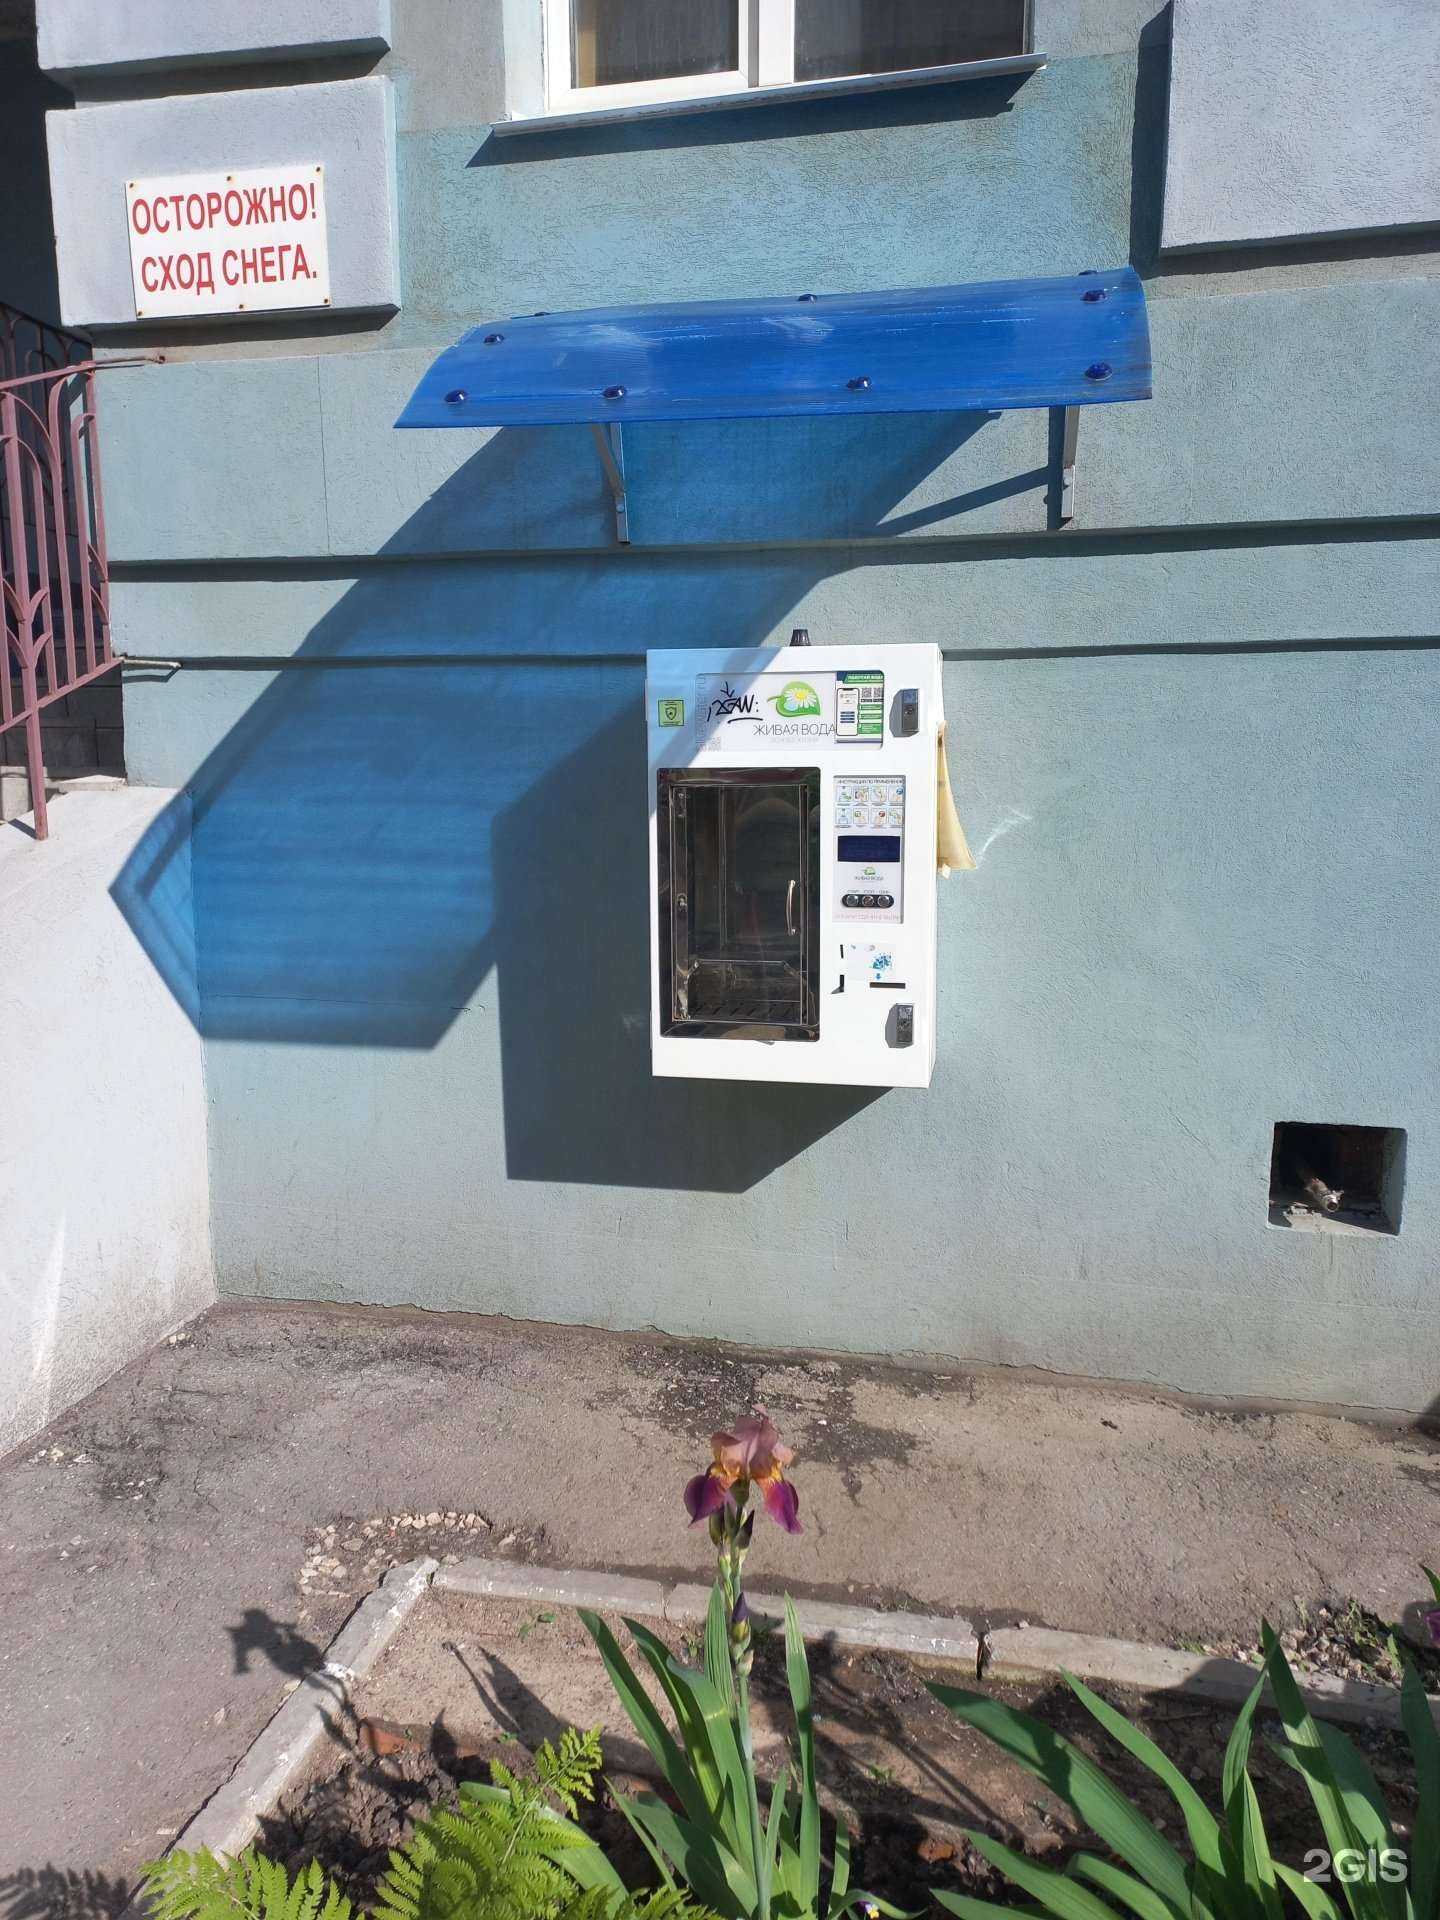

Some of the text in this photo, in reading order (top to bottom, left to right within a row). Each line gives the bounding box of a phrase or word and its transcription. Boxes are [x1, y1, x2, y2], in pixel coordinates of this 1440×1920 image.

[132, 182, 317, 235] ОСТОРОЖНО!
[141, 244, 317, 295] СХОД СНЕГА.
[753, 723, 835, 737] ЖИВАЯ ВОДА
